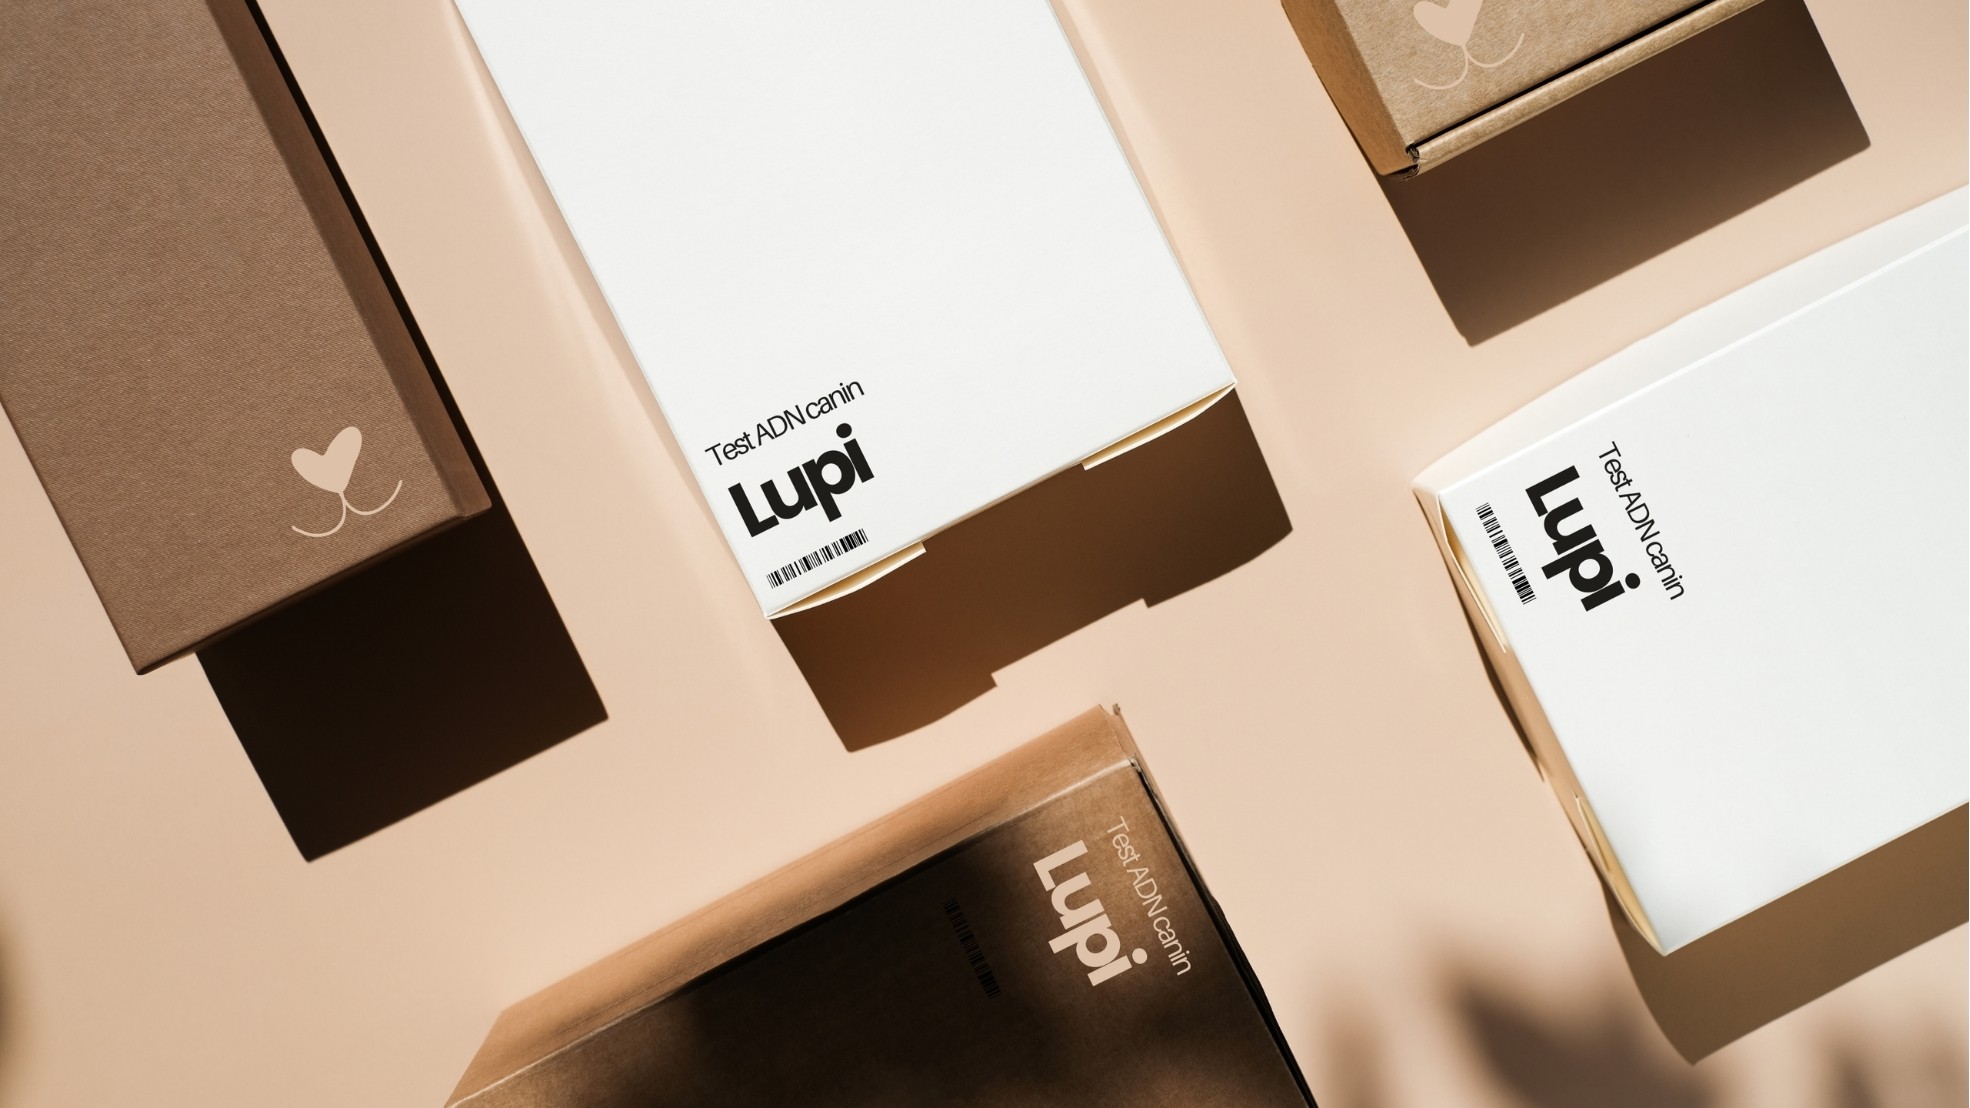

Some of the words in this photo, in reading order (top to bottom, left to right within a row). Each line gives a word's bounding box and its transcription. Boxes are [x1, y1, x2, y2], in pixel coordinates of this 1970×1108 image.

[704, 431, 756, 466] Test
[756, 404, 807, 447] ADN
[805, 380, 865, 419] canin
[728, 422, 875, 538] Lupi
[1525, 465, 1641, 612] Lupi
[1598, 440, 1633, 492] Test
[1618, 491, 1660, 543] ADN
[1645, 541, 1685, 601] canin
[1033, 839, 1148, 987] Lupi
[1107, 815, 1141, 867] Test
[1126, 866, 1168, 918] ADN
[1153, 916, 1192, 976] canin
